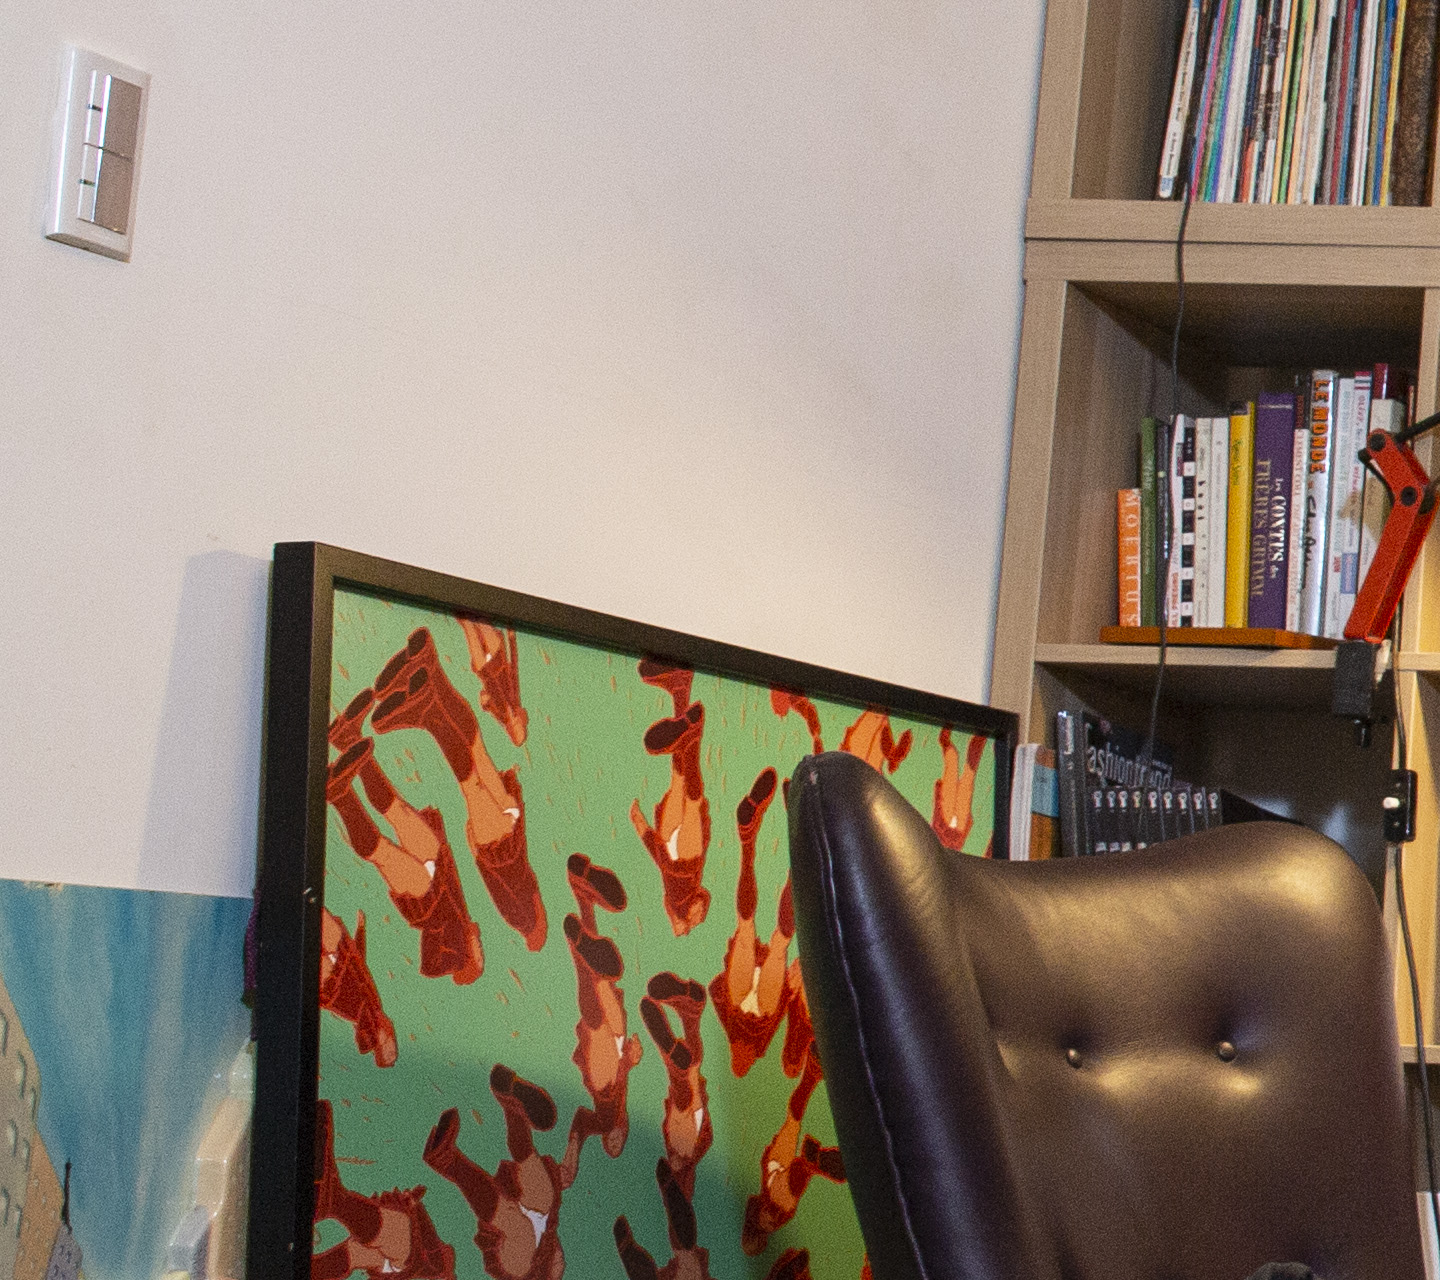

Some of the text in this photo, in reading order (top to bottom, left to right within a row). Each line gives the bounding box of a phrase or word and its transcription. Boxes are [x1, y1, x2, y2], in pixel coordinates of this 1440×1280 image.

[1310, 380, 1330, 474] LE MONDE
[1258, 495, 1276, 564] CONTES
